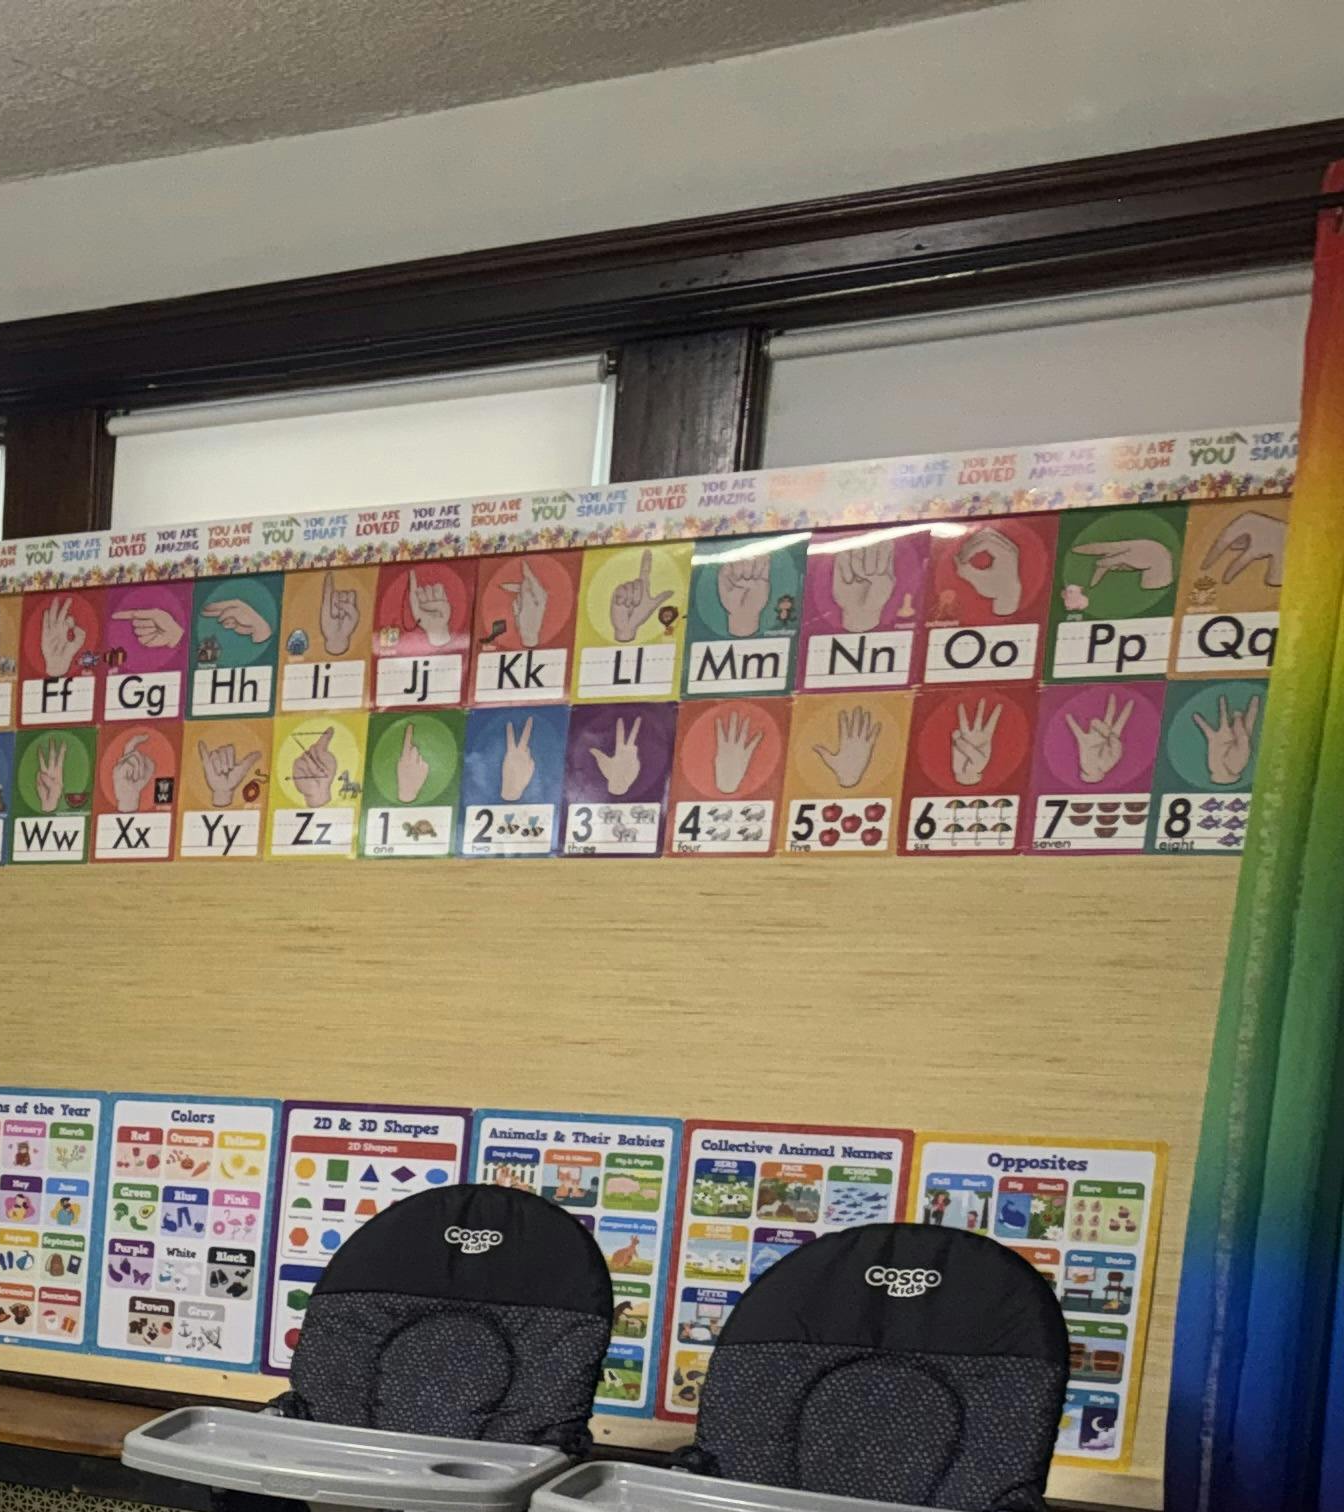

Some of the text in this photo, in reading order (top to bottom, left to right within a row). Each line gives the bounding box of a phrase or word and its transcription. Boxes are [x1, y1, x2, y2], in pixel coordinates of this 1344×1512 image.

[958, 465, 1015, 486] LOVED
[636, 495, 688, 513] LOVED
[410, 518, 461, 532] AMAZING
[944, 630, 1019, 669] Oo
[1088, 624, 1147, 672] Pp
[1198, 616, 1279, 667] Qq
[698, 645, 779, 682] Mm
[829, 635, 895, 674] Nn
[404, 661, 430, 701] Jj
[498, 652, 546, 689] Kk
[41, 679, 74, 713] Ff
[118, 677, 166, 713] Gg
[211, 670, 259, 703] Hh
[296, 813, 332, 845] Zz
[378, 812, 390, 842] 1
[474, 809, 493, 840] 2
[573, 808, 593, 841] 3
[679, 806, 700, 839] 4
[791, 804, 814, 841] 5
[914, 802, 937, 839] 6
[1046, 800, 1070, 838] 7
[1163, 799, 1191, 838] 8
[21, 821, 79, 852] Ww
[113, 817, 150, 848] Xx
[201, 815, 240, 855] Yy
[1033, 838, 1071, 849] seven
[1159, 839, 1195, 854] eight
[15, 1102, 29, 1115] of
[34, 1103, 55, 1115] the
[60, 1104, 91, 1118] Year
[171, 1110, 215, 1124] Colors
[5, 1124, 43, 1136] February
[130, 1130, 150, 1141] Red
[170, 1132, 209, 1145] Orange
[314, 1117, 439, 1138] 2D & 3D Shapes
[489, 1127, 665, 1149] Animals & Their Babies
[347, 1142, 398, 1154] 2D Shapes
[701, 1138, 893, 1161] Collective Animal Names
[987, 1152, 1089, 1173] Opposites
[118, 1186, 152, 1199] Green
[223, 1193, 250, 1207] Pink
[447, 1228, 502, 1245] Cosco
[114, 1242, 150, 1256] Purple
[166, 1247, 196, 1259] White
[216, 1252, 247, 1264] Black
[867, 1267, 941, 1286] Cosco
[890, 1283, 925, 1296] kids
[134, 1301, 169, 1314] Brown
